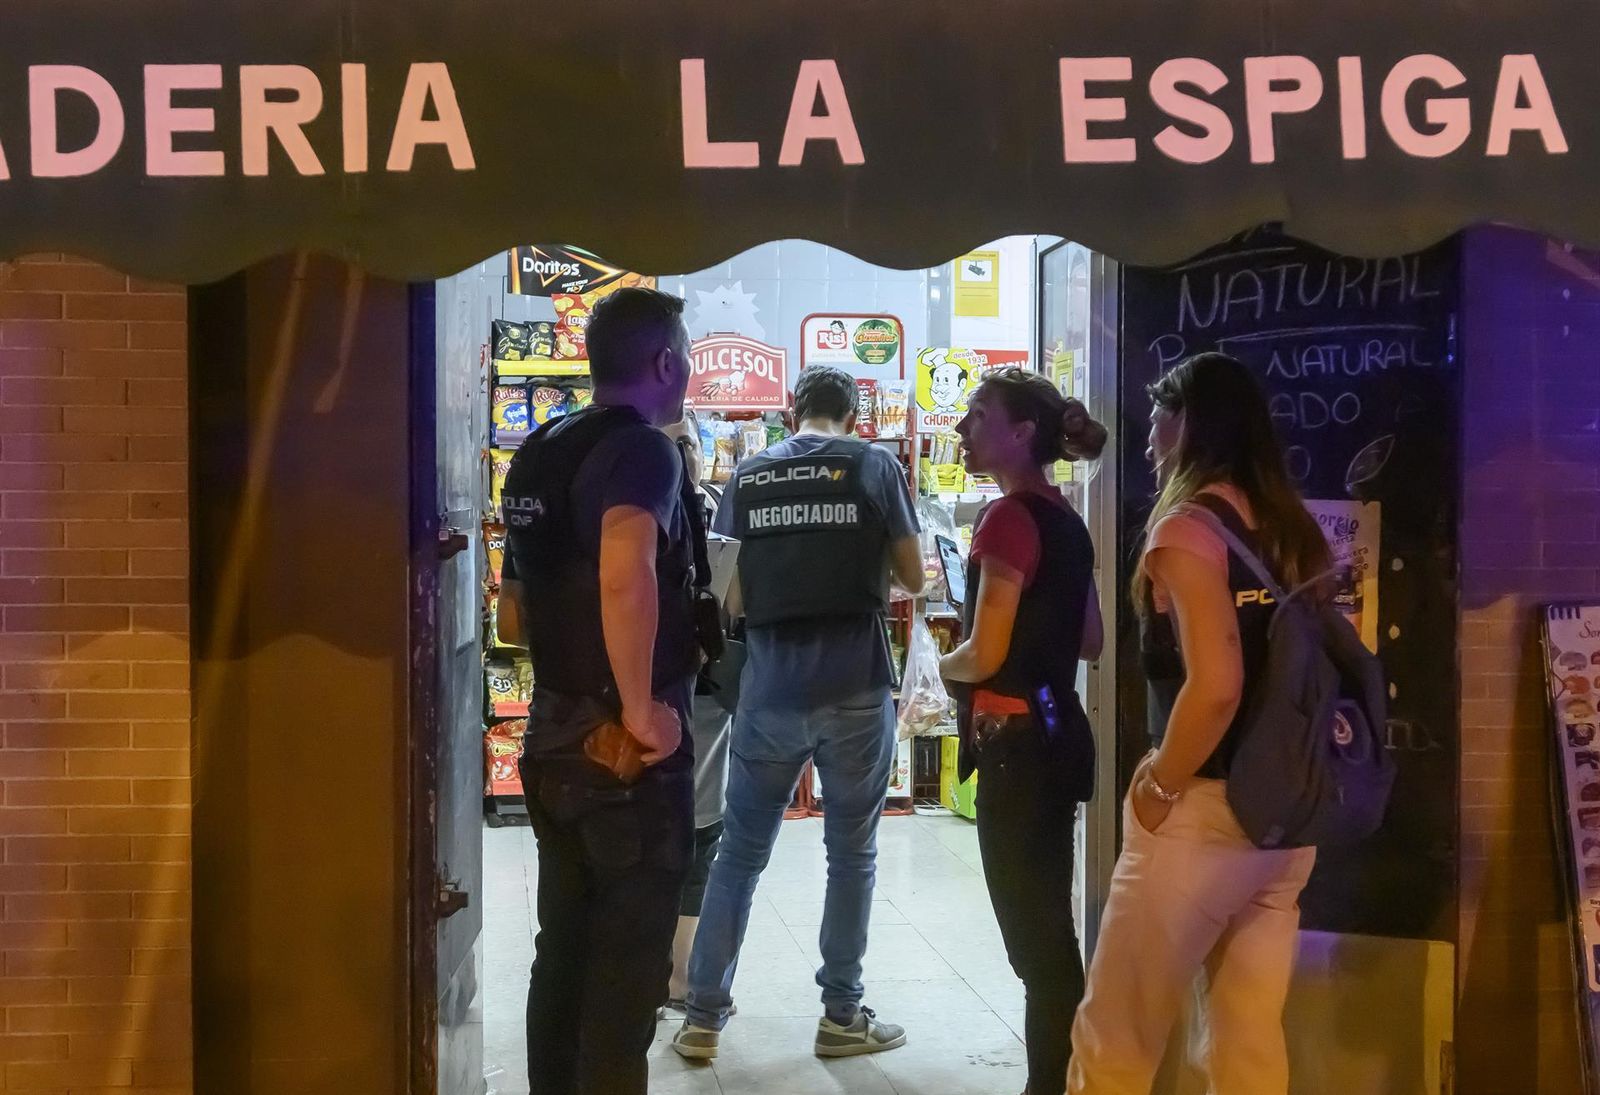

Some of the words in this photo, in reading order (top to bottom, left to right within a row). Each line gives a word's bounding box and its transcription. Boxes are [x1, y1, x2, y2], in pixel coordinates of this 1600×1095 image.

[0, 61, 477, 180] DERIA
[680, 58, 866, 168] LA
[1059, 53, 1569, 164] ESPIGA
[522, 257, 580, 277] Doritos
[1178, 257, 1440, 331] NATURAL
[818, 332, 845, 346] Risi
[953, 351, 974, 359] desde
[968, 356, 986, 364] 1932
[1266, 339, 1432, 379] NATURAL
[493, 386, 527, 404] Ruffles
[534, 389, 566, 405] Ruffles
[1272, 392, 1361, 429] ADO
[739, 466, 832, 488] POLICIA
[749, 503, 857, 529] NEGOCIADOR
[1310, 512, 1360, 534] orejo
